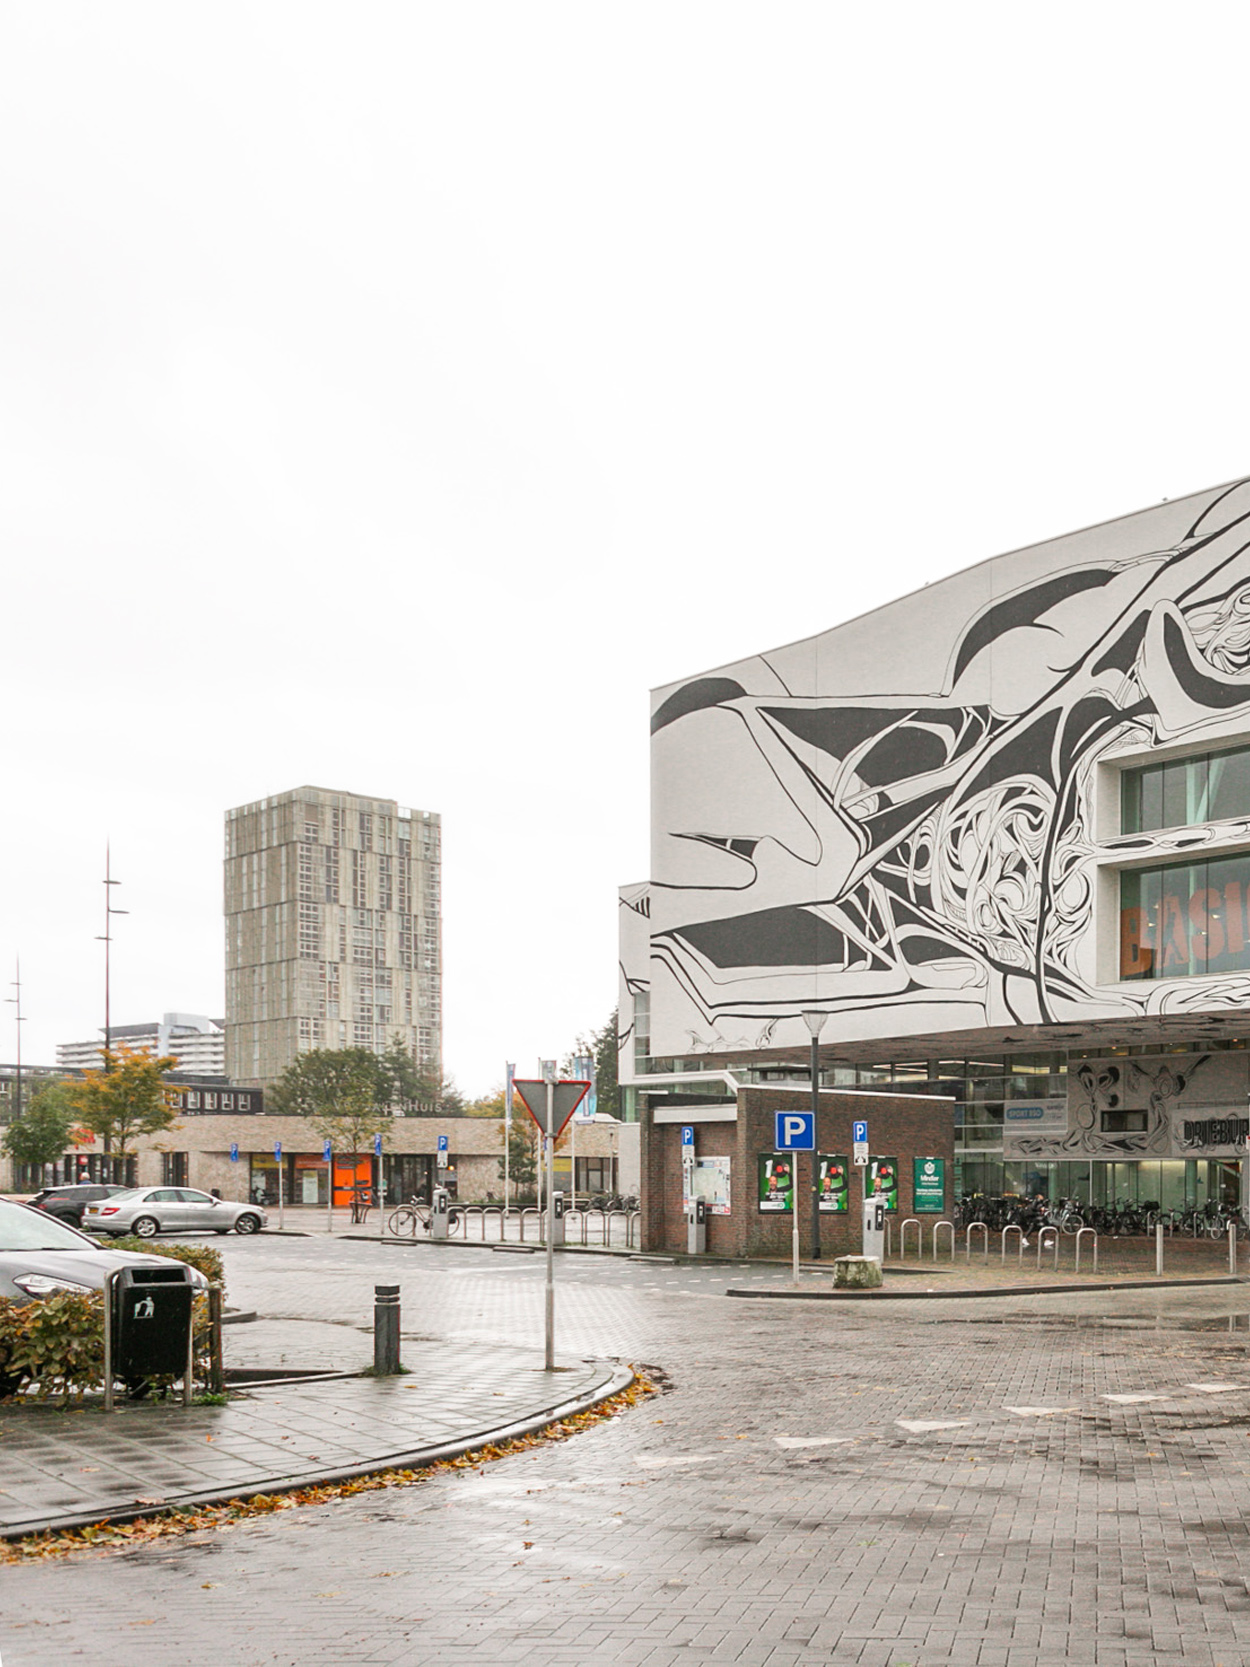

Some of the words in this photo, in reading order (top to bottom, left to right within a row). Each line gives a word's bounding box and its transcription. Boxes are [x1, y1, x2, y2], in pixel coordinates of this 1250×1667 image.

[684, 1129, 691, 1144] P
[784, 1116, 806, 1146] P
[856, 1124, 864, 1140] P
[440, 1137, 446, 1149] P
